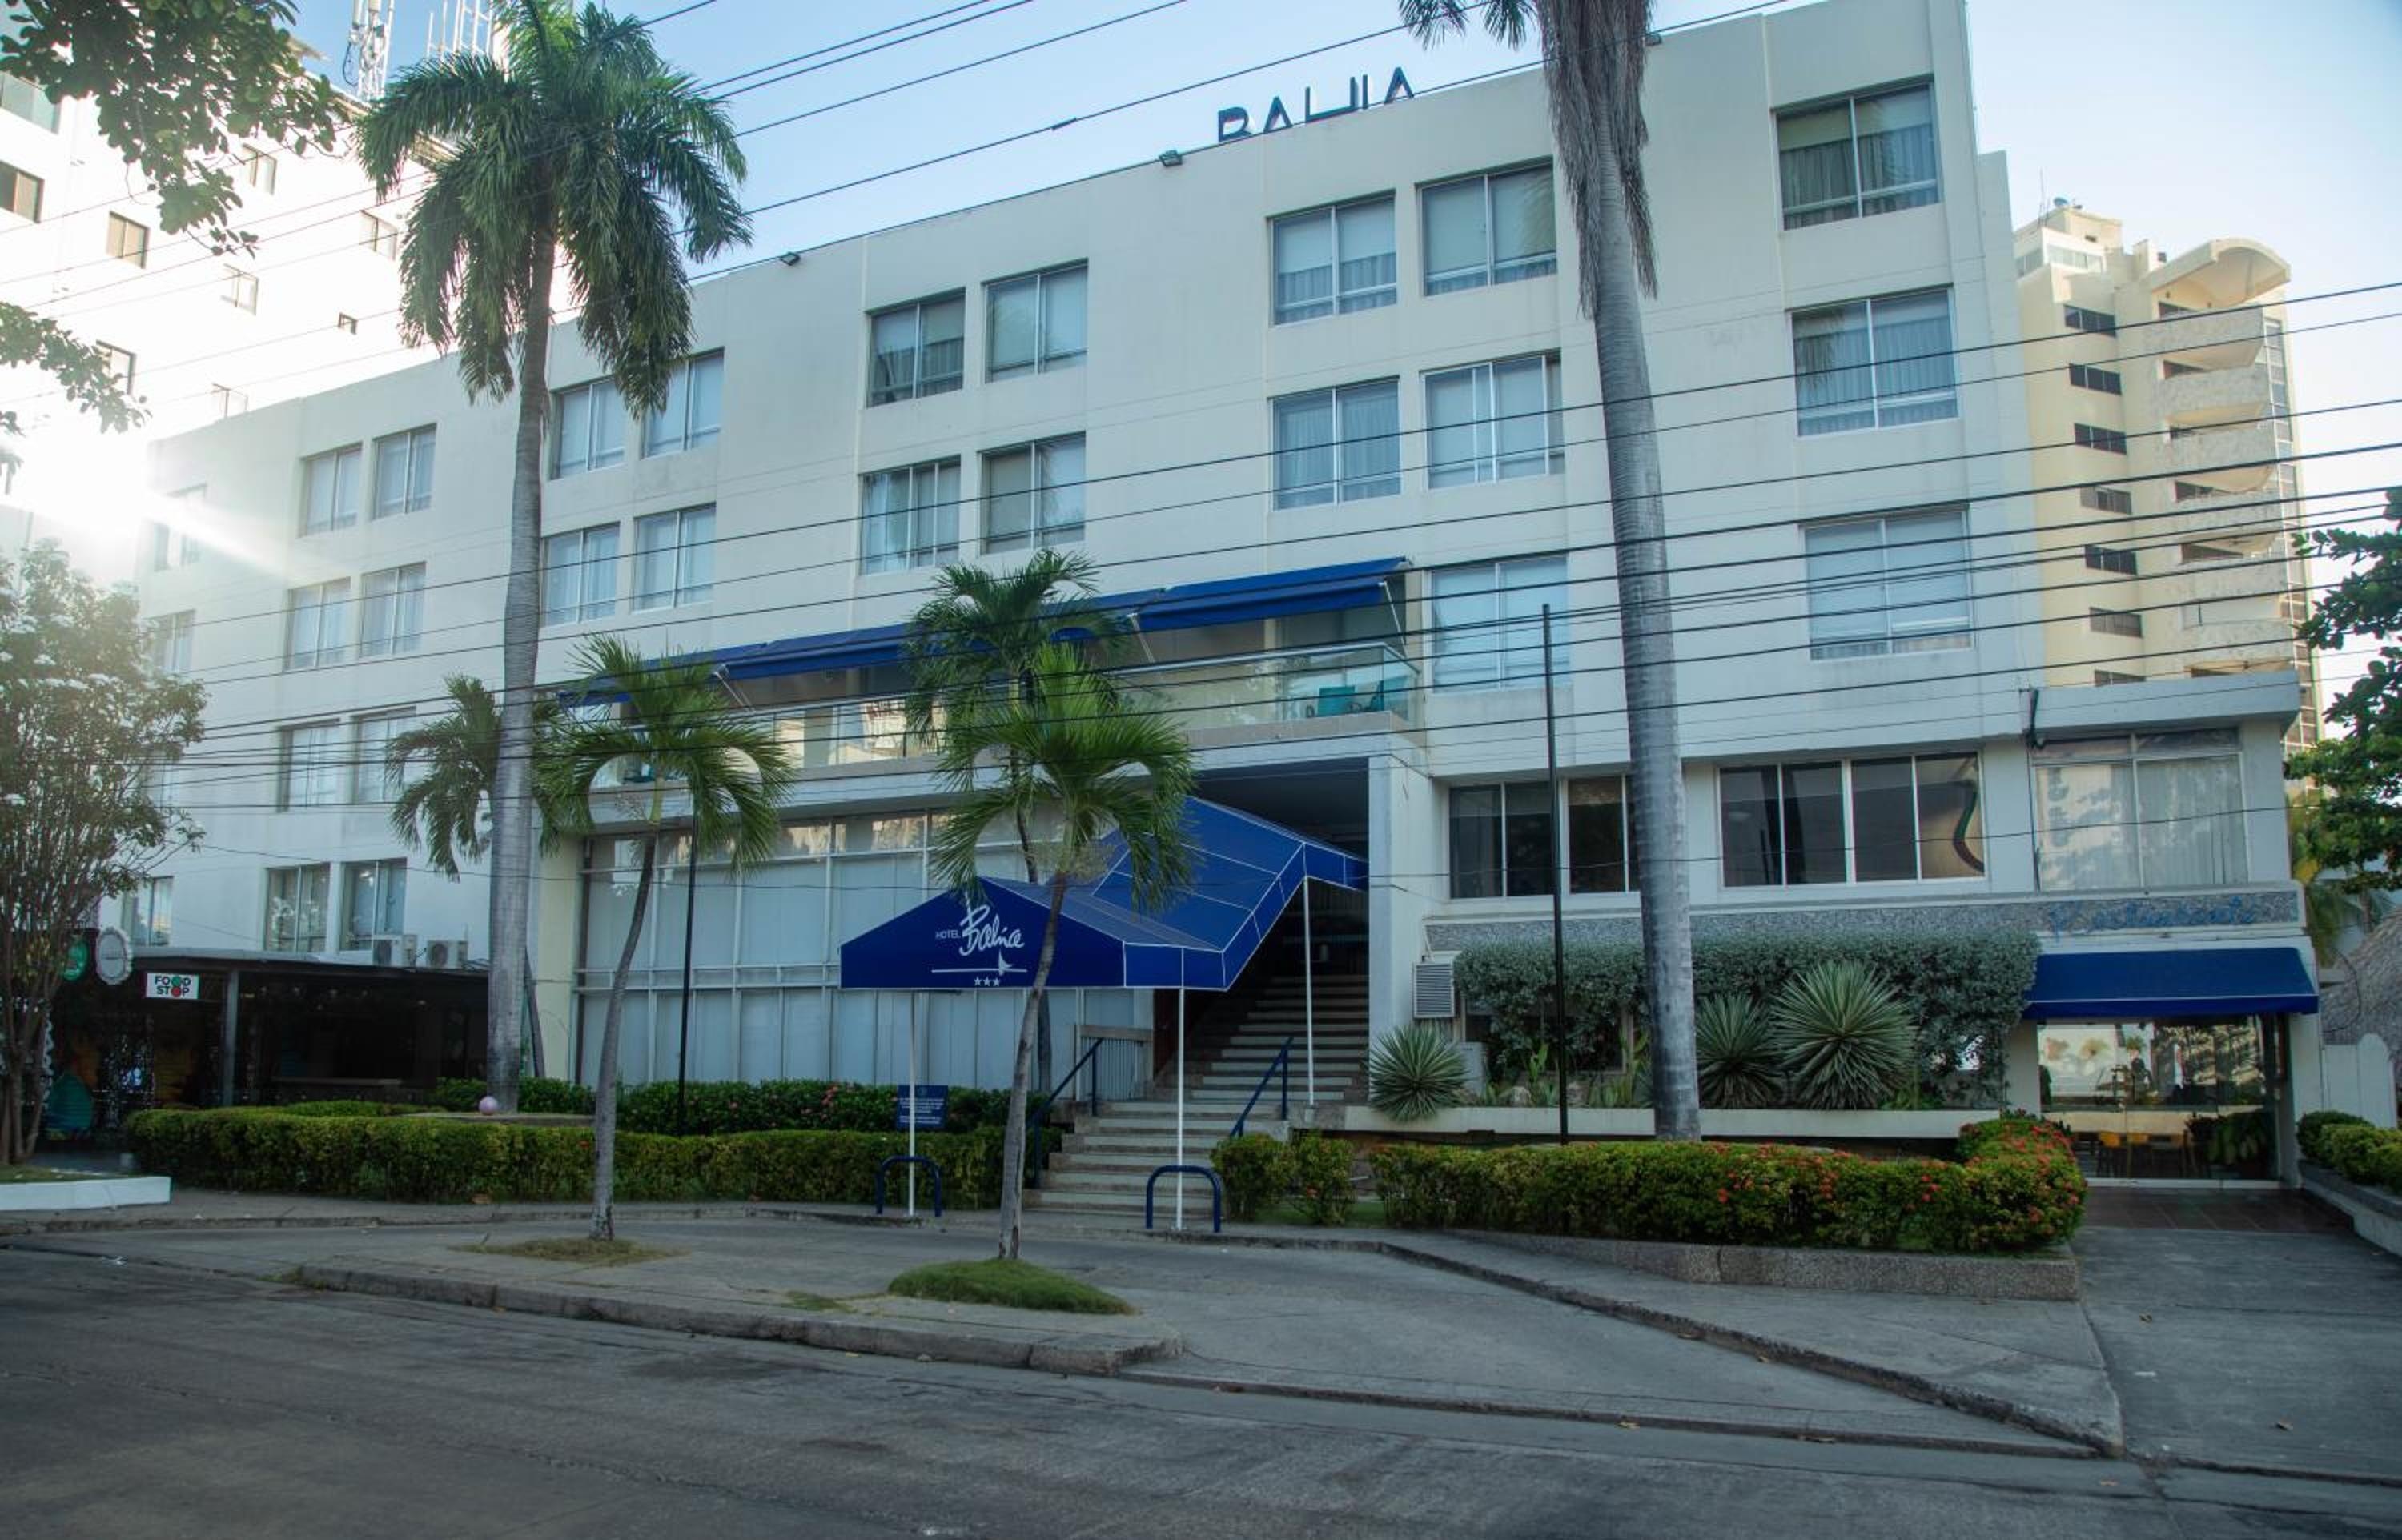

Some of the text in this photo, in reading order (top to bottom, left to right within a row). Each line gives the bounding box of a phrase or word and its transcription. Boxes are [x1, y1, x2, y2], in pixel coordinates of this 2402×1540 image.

[935, 929, 961, 940] HOTEL
[155, 975, 191, 987] FOOD
[156, 985, 190, 997] STOP
